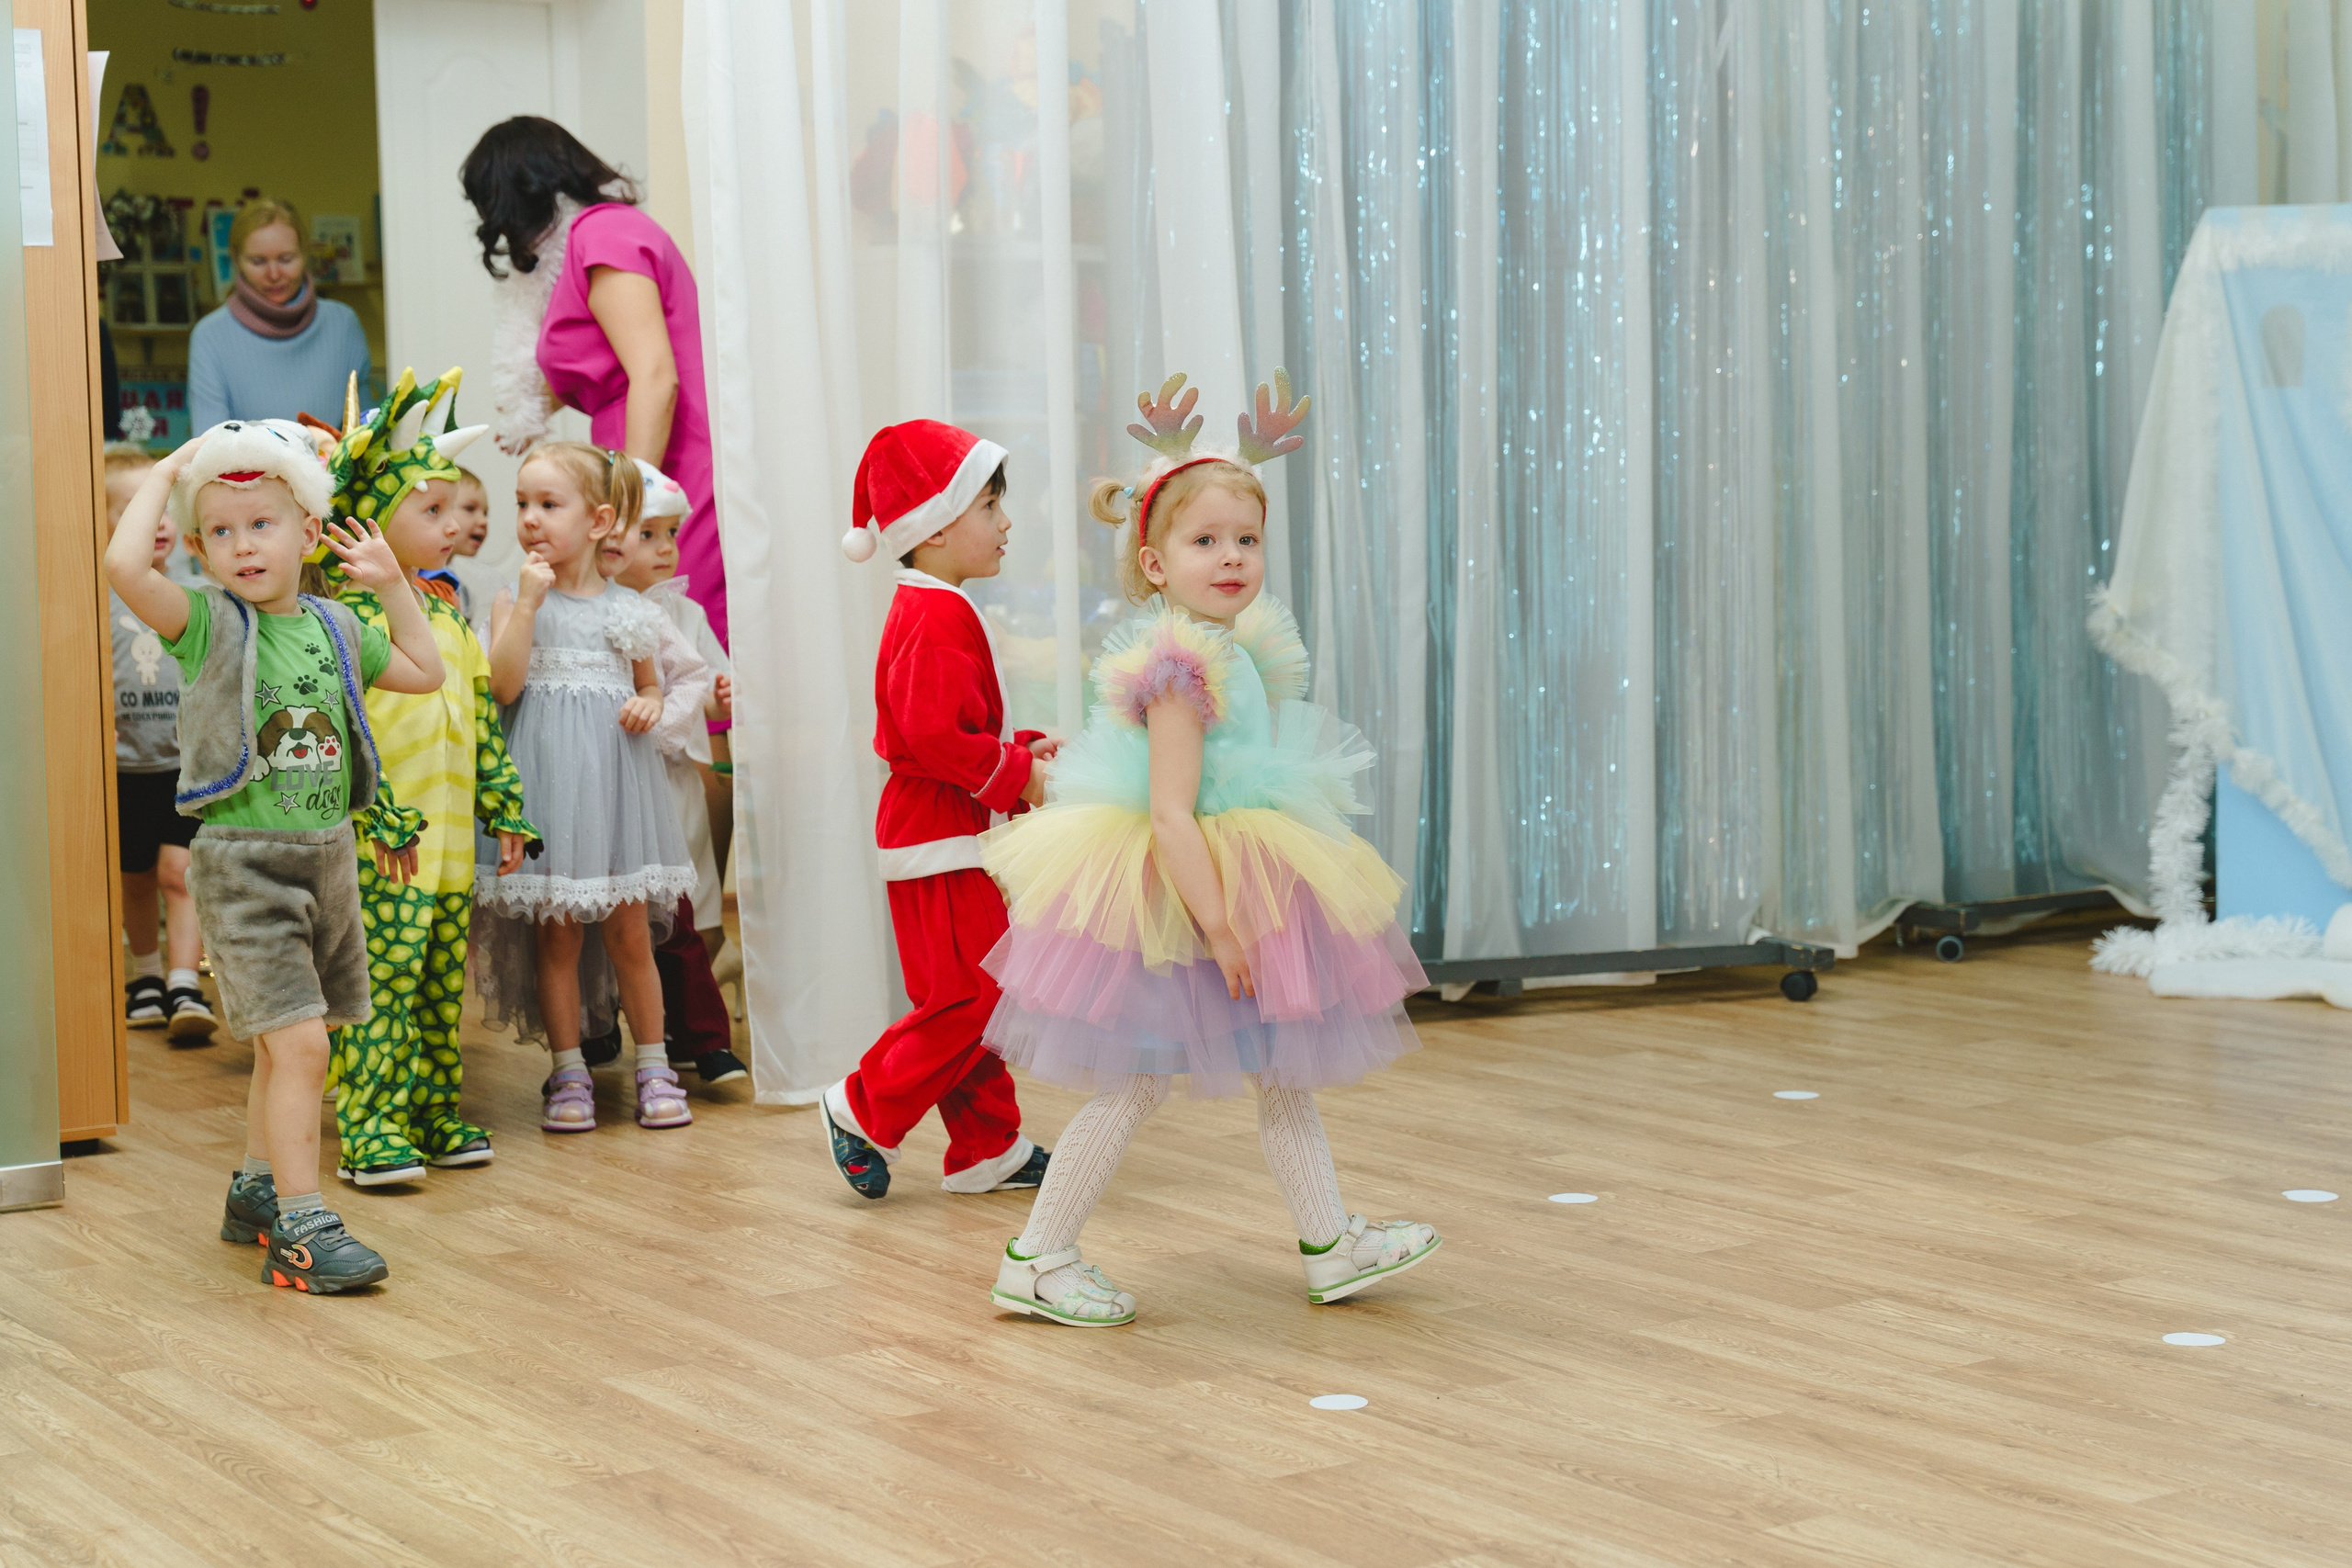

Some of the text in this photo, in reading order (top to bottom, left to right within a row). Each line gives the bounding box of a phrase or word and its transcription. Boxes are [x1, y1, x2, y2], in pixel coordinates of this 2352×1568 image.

[120, 691, 138, 707] СО
[271, 761, 334, 791] LOVE
[293, 1213, 339, 1236] FASHION
